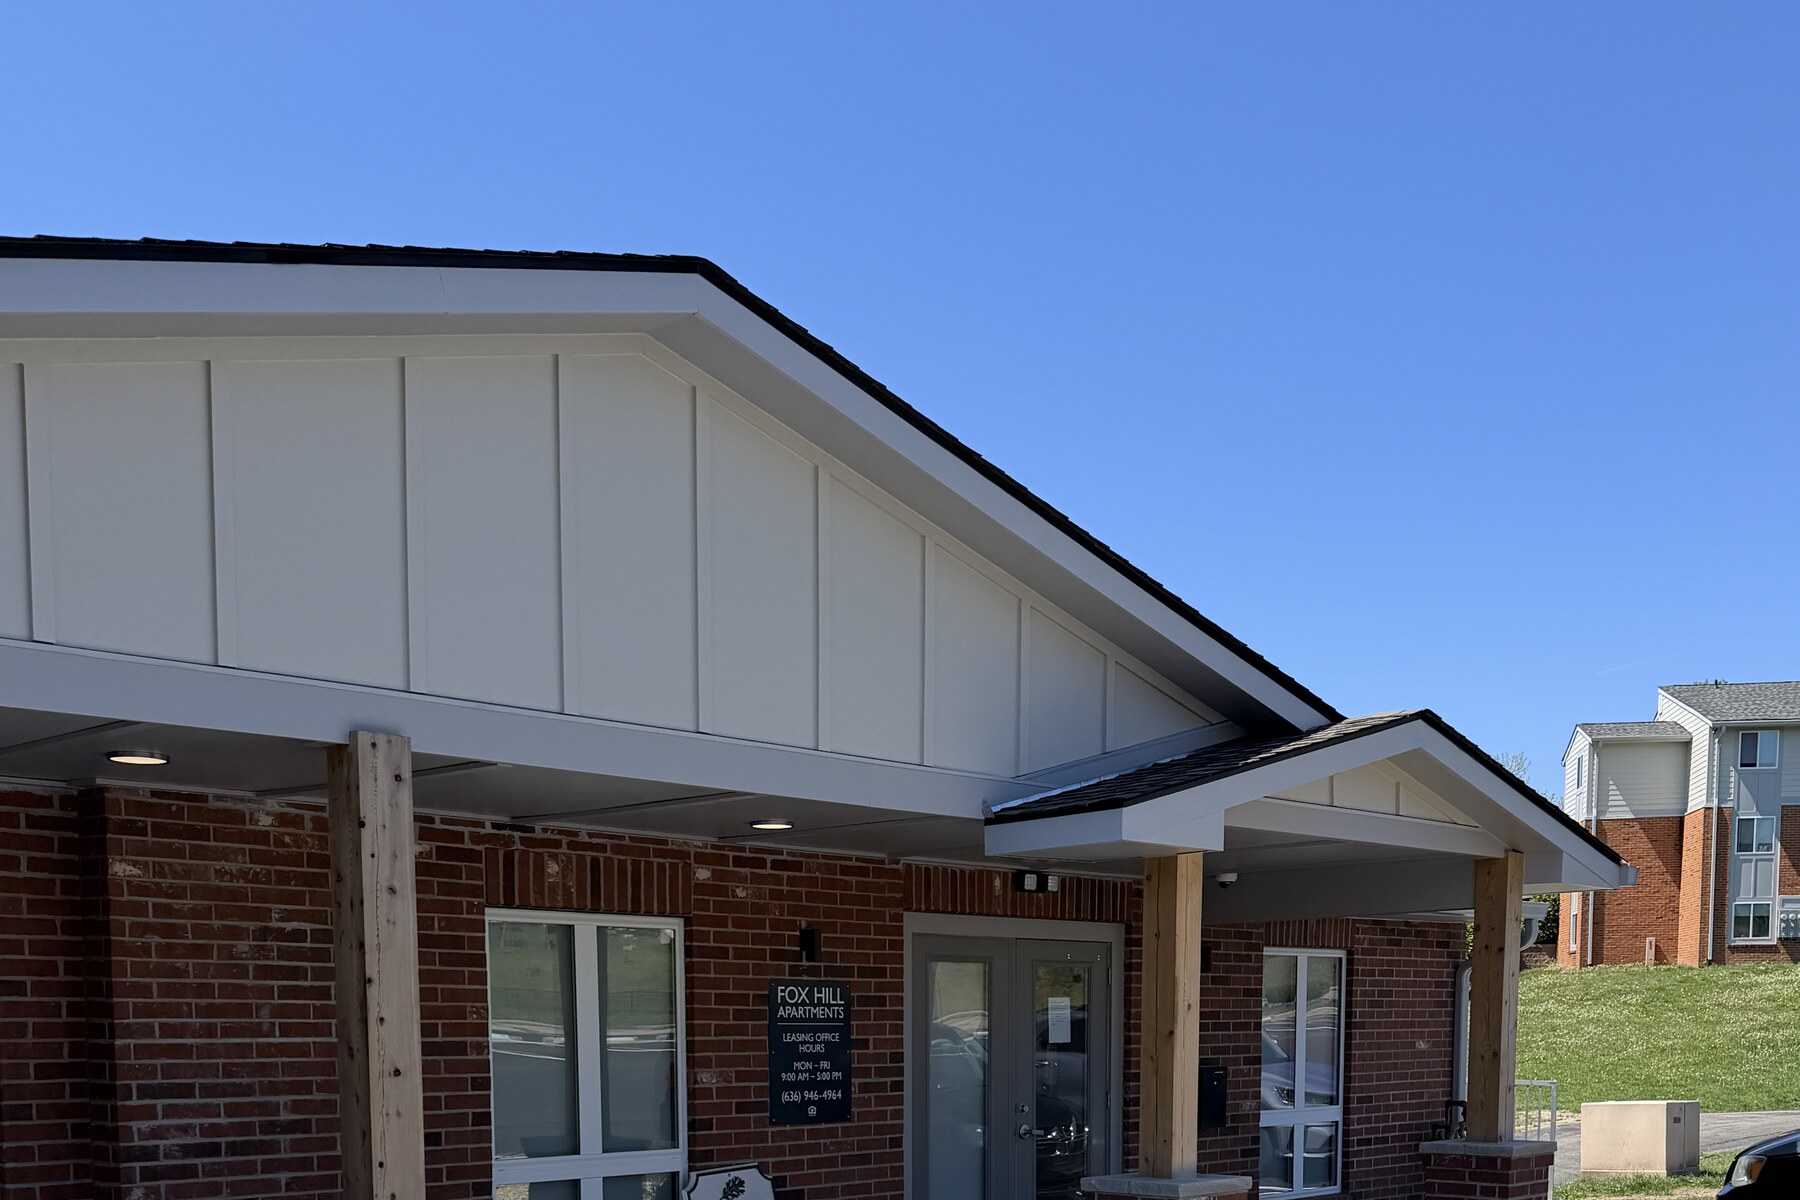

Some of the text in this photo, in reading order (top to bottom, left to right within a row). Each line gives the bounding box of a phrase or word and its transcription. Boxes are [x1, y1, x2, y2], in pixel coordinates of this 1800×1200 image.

[778, 986, 845, 1004] FOX HILL
[777, 1006, 844, 1019] APARTMENTS
[783, 1033, 840, 1042] LEASING OFFICE
[799, 1043, 825, 1053] HOURS
[793, 1061, 812, 1070] MON
[820, 1061, 831, 1070] FRI
[781, 1072, 796, 1081] 9:00
[797, 1072, 809, 1081] AM
[816, 1071, 830, 1080] 5:00
[831, 1071, 842, 1080] PM
[781, 1090, 842, 1104] (636) 946-4964
